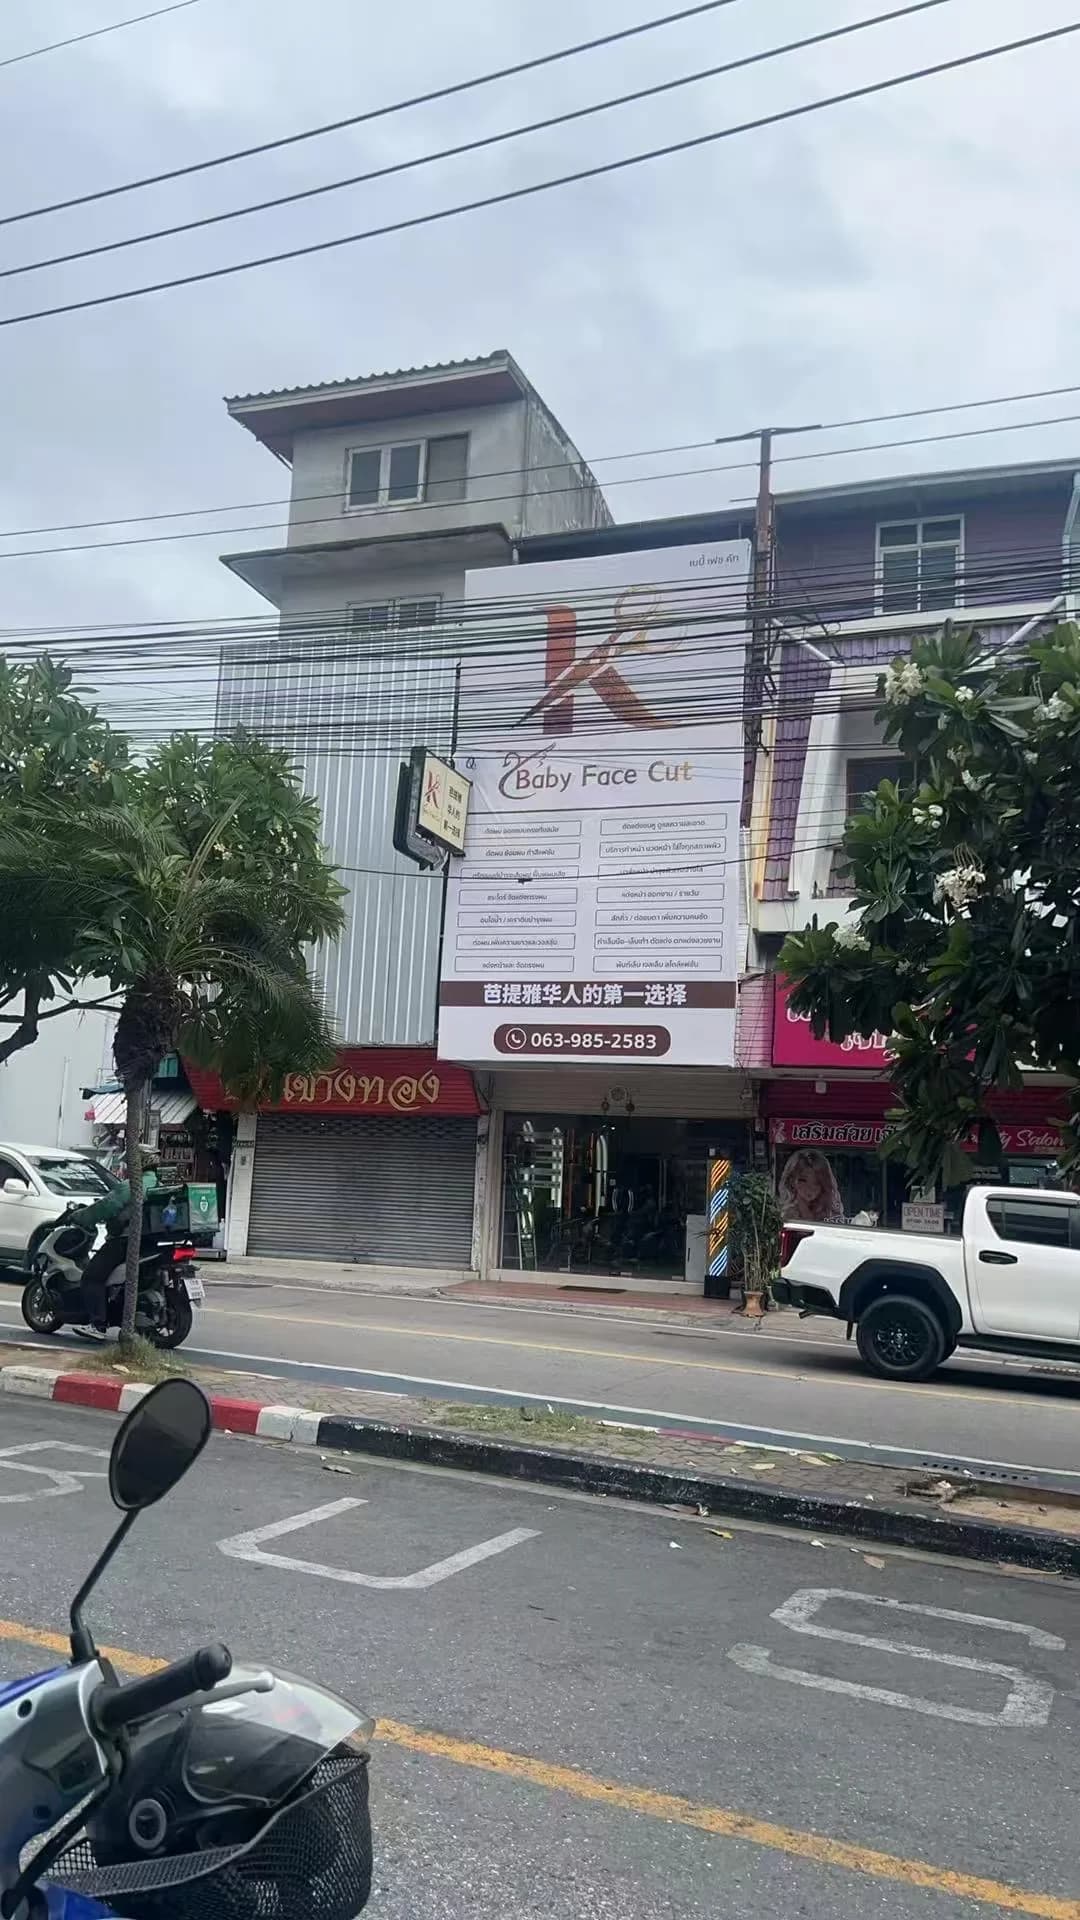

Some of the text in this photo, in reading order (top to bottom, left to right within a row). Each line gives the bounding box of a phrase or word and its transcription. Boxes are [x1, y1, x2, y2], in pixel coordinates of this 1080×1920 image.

[515, 760, 694, 793] Baby Face Cut
[483, 983, 688, 1006] 芭提雅华人的第一选择
[530, 1032, 658, 1050] 063-985-2583
[1015, 1129, 1064, 1147] Salon
